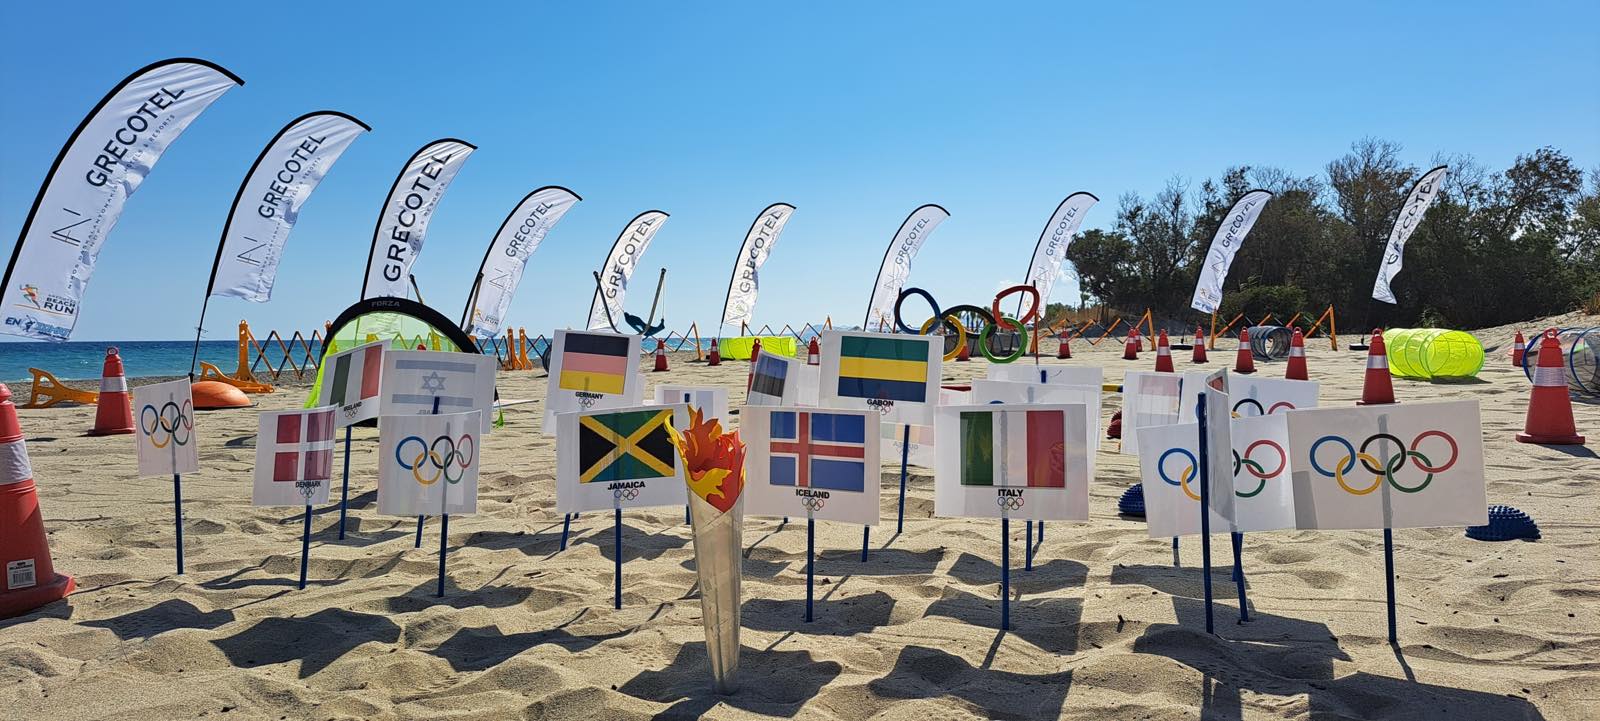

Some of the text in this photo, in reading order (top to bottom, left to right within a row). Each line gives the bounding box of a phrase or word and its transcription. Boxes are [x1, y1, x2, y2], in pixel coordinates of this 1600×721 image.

[86, 87, 185, 187] GRECOTEL
[258, 135, 327, 219] GRECOTEL
[383, 153, 452, 282] GRECOTEL
[505, 202, 553, 257] GRECOTEL
[1045, 205, 1079, 257] GRECOTEL
[739, 210, 783, 293] GRECOTEL
[895, 217, 930, 265] GRECOTEL
[606, 217, 656, 299] GRECOTEL
[44, 302, 75, 314] RUN
[46, 297, 76, 307] BEACH
[575, 391, 603, 399] GERMANY
[866, 398, 894, 406] GABON
[295, 480, 321, 488] DENMARK
[607, 480, 646, 490] JAMAICA
[795, 488, 830, 499] ICELAND
[998, 488, 1024, 497] ITALY
